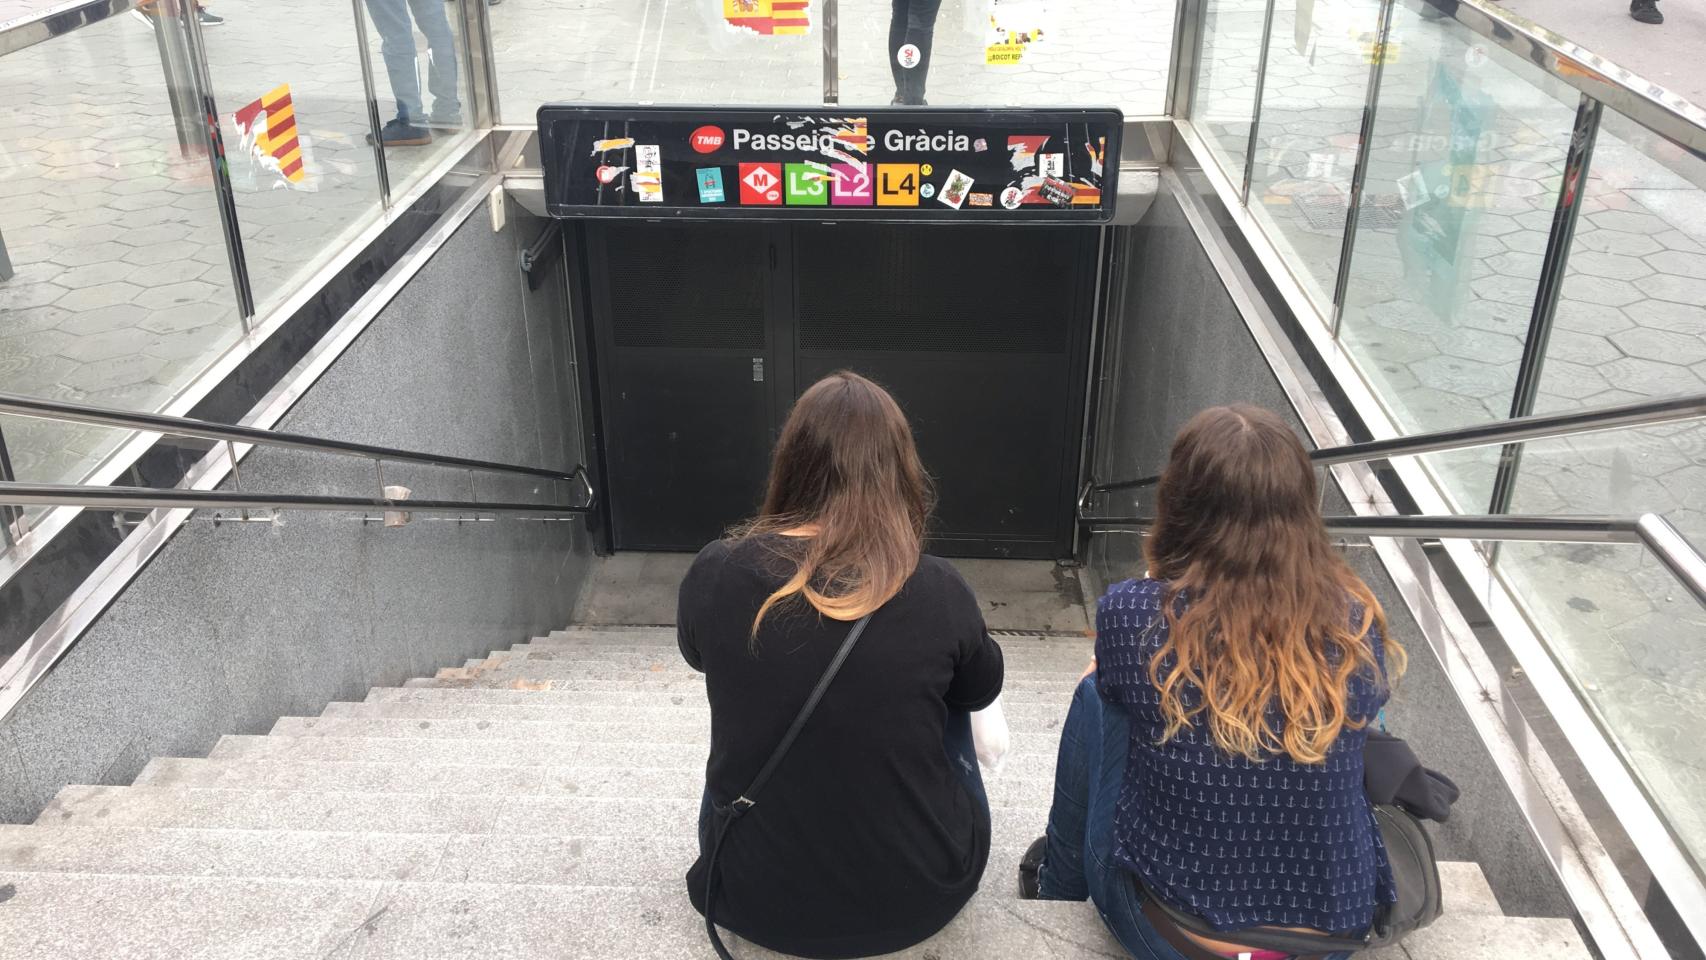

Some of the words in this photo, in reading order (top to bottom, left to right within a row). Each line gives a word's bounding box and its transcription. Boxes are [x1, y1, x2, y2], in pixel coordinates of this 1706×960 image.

[697, 135, 722, 145] TMB
[733, 128, 835, 156] Passeig
[884, 128, 970, 152] Gràcia
[753, 174, 768, 187] M
[790, 172, 824, 196] L3
[834, 172, 870, 197] L2
[882, 172, 916, 196] L4
